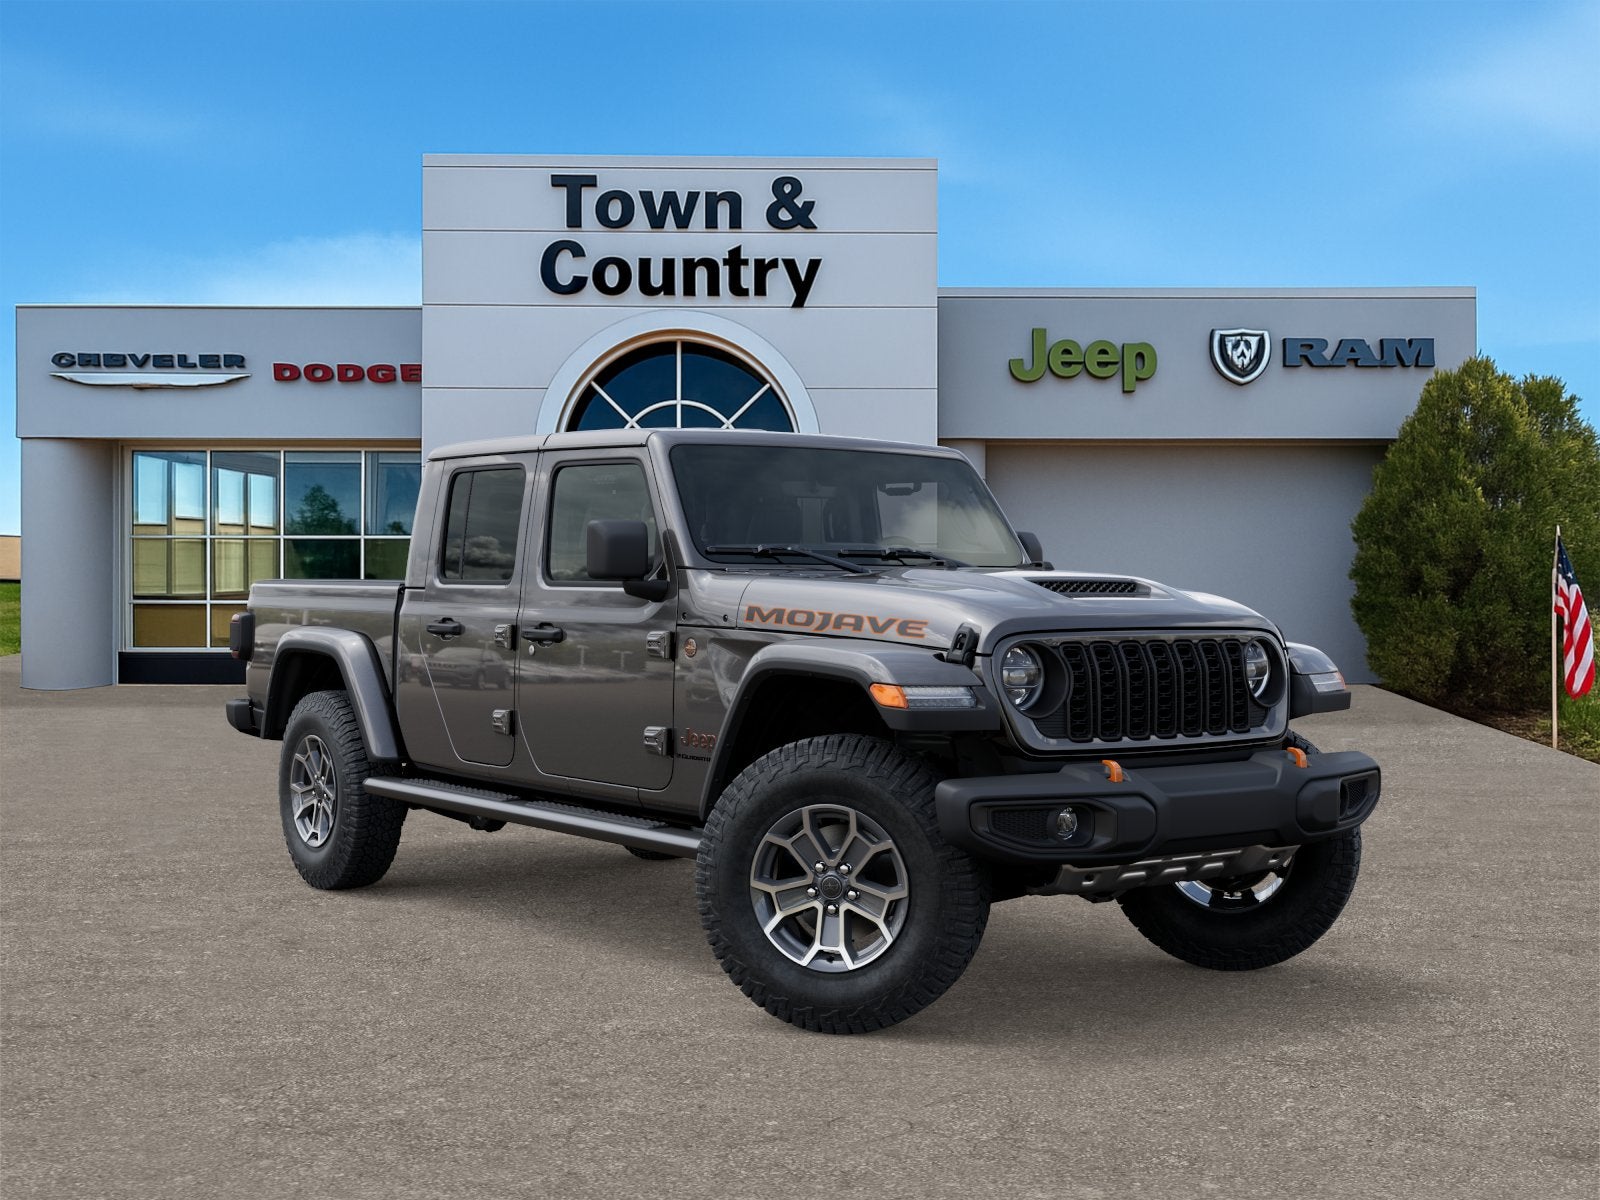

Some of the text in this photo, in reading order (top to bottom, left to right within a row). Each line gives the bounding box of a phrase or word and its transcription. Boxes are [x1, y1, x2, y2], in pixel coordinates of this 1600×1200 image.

[550, 174, 818, 230] Town &
[539, 239, 823, 308] Country
[1008, 327, 1158, 393] Jeep
[1282, 337, 1436, 368] RAM
[272, 362, 422, 383] DODGE
[744, 604, 929, 639] MOJAVE
[680, 727, 716, 753] Jeep
